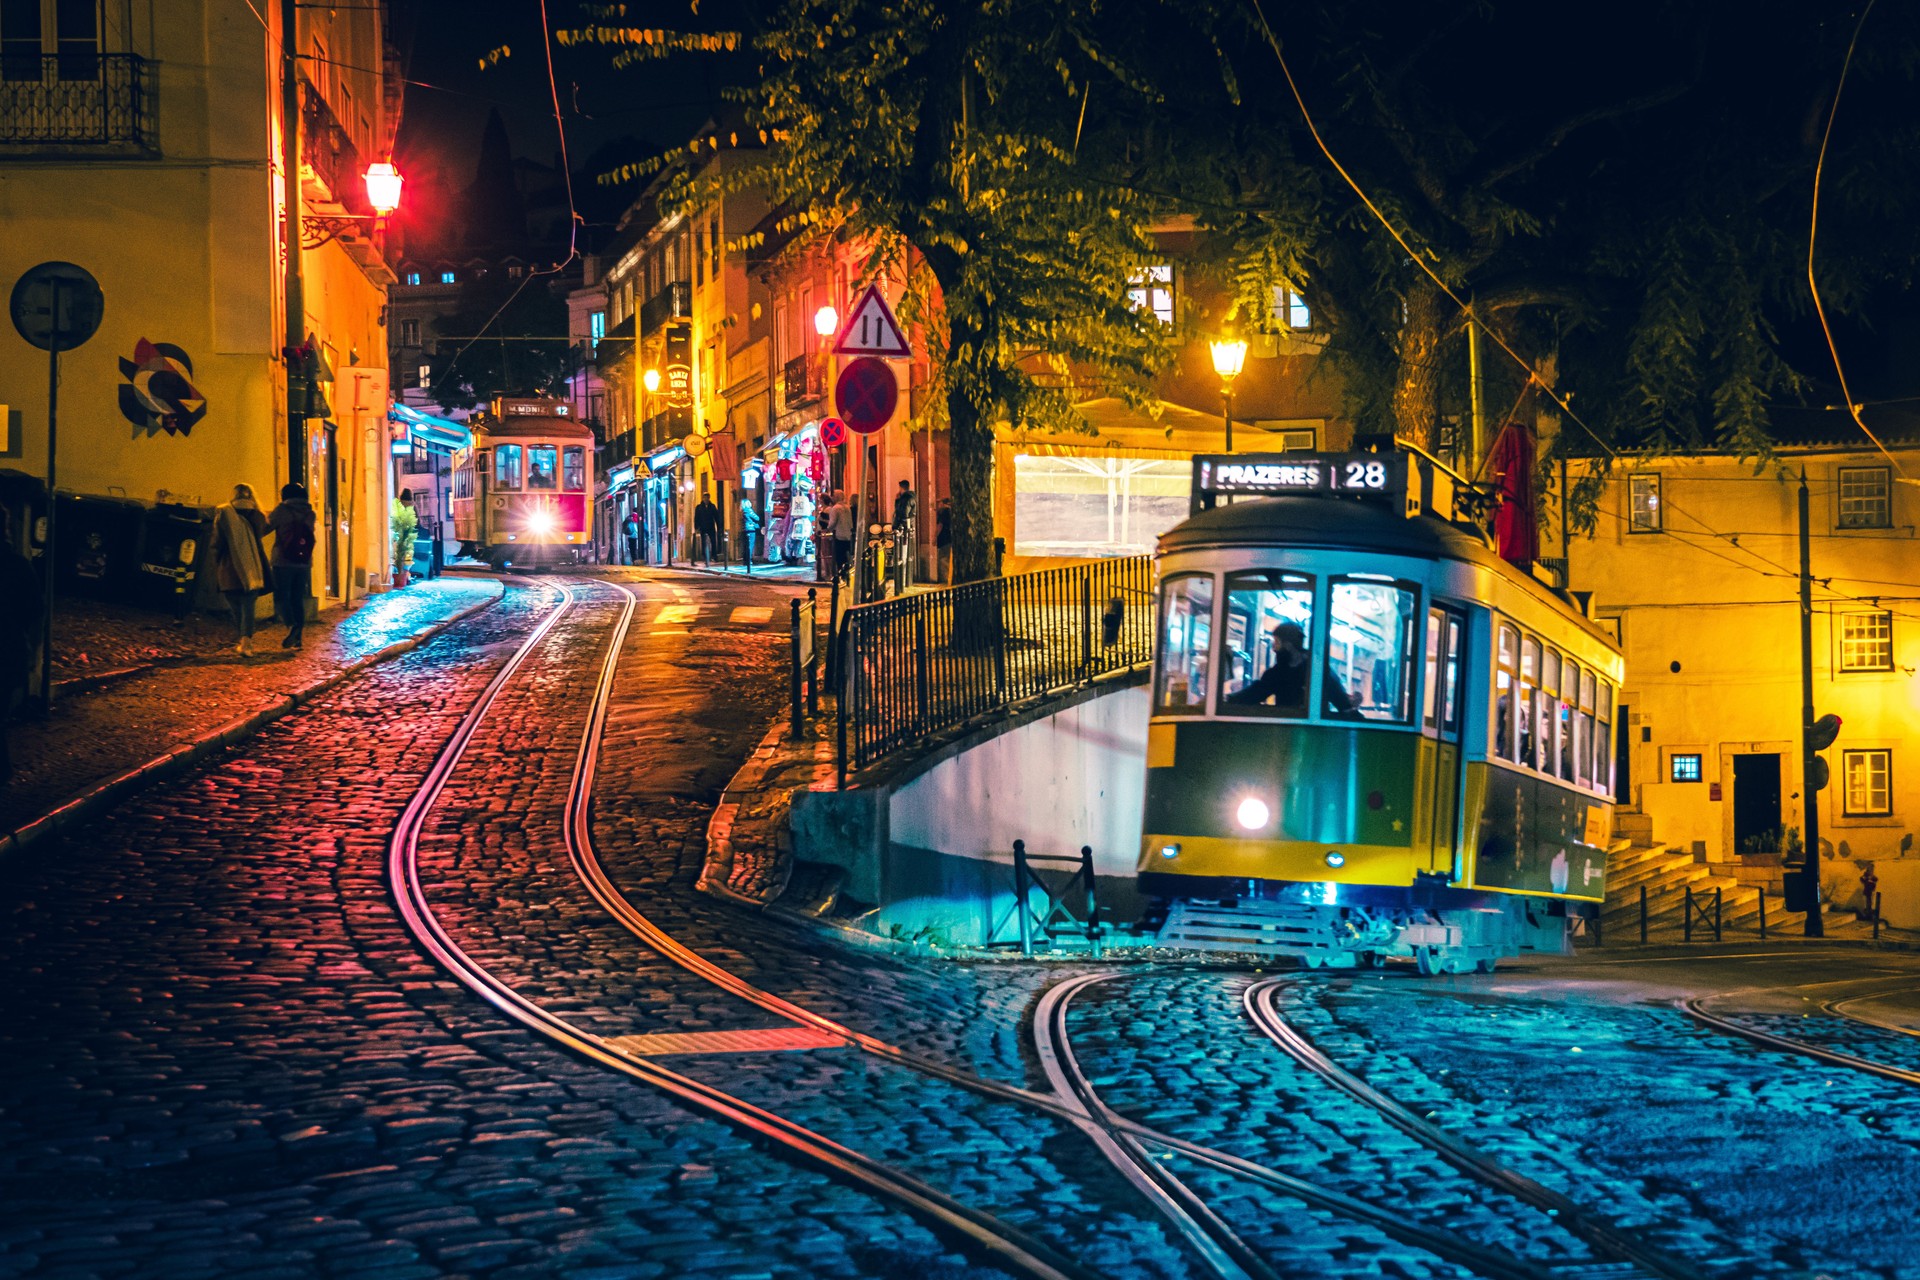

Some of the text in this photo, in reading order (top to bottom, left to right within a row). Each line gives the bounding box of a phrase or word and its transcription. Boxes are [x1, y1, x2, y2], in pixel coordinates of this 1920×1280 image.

[556, 406, 568, 415] 12
[1216, 462, 1386, 488] PRAZERES 28
[153, 566, 177, 576] PAPE
